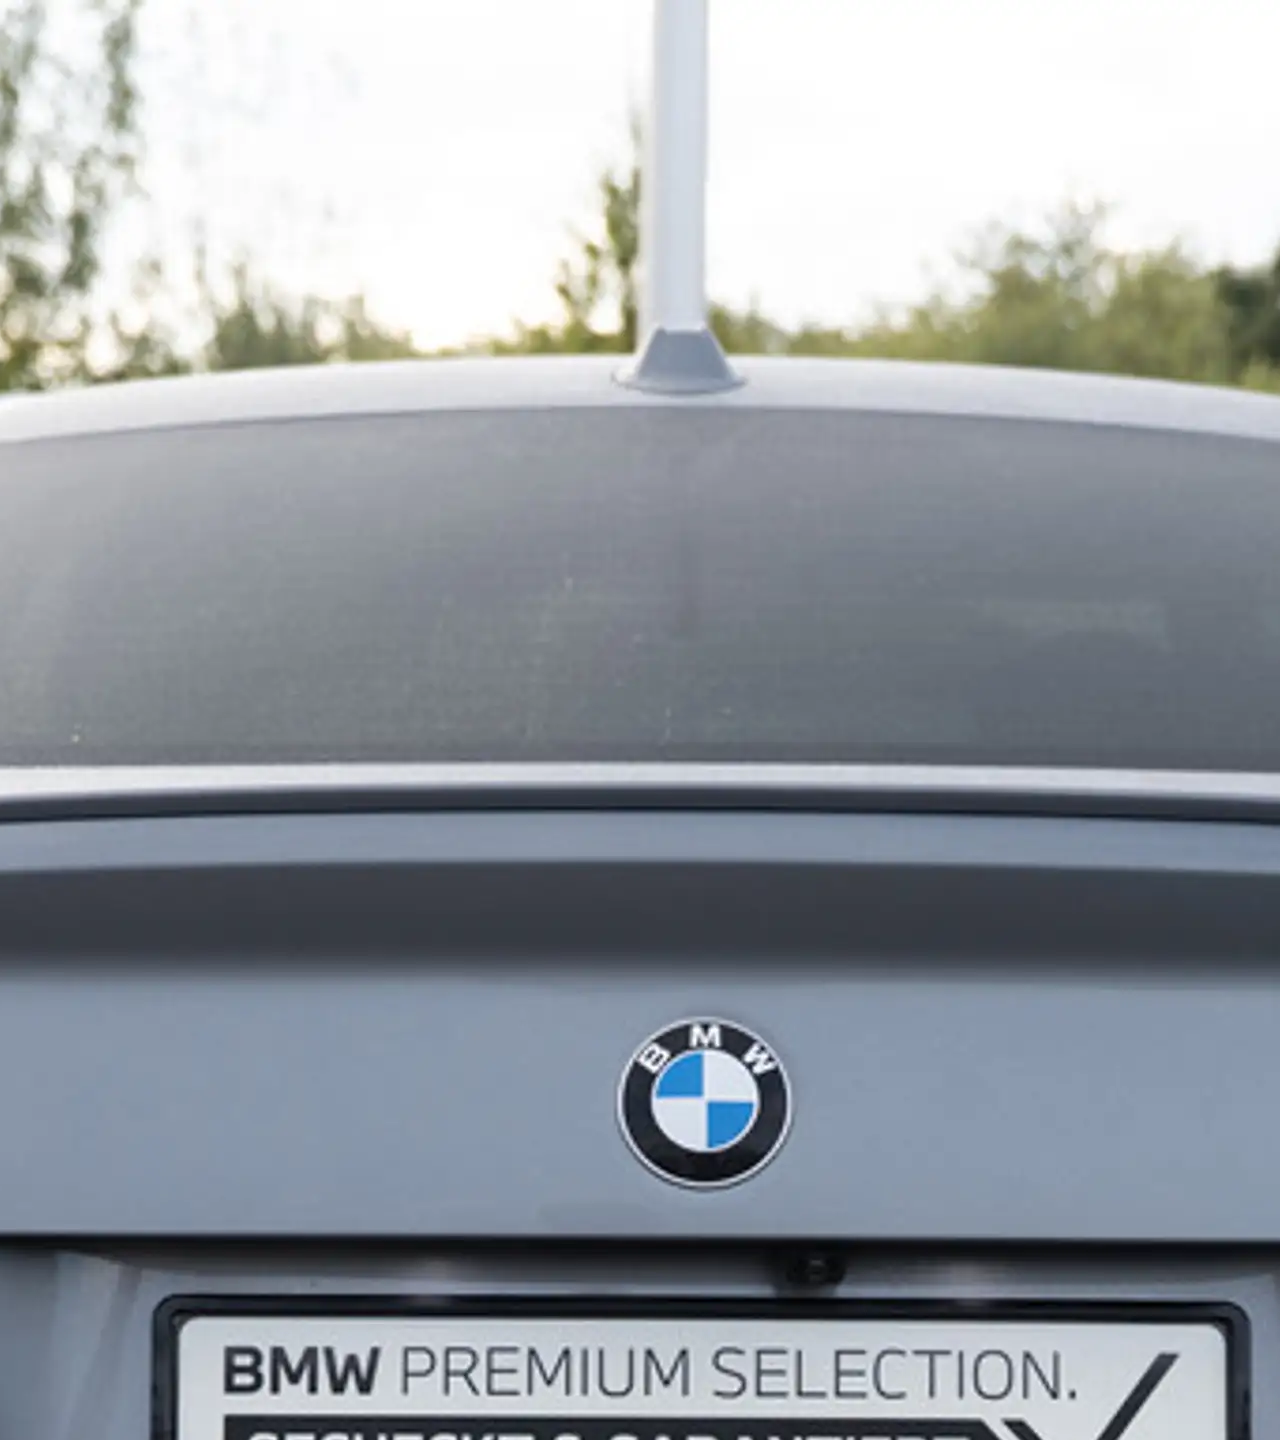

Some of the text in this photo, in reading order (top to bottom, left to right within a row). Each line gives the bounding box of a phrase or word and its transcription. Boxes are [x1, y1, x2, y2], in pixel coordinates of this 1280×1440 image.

[638, 1023, 777, 1075] BMW
[223, 1345, 1078, 1401] BMW PREMIUM SELECTION.
